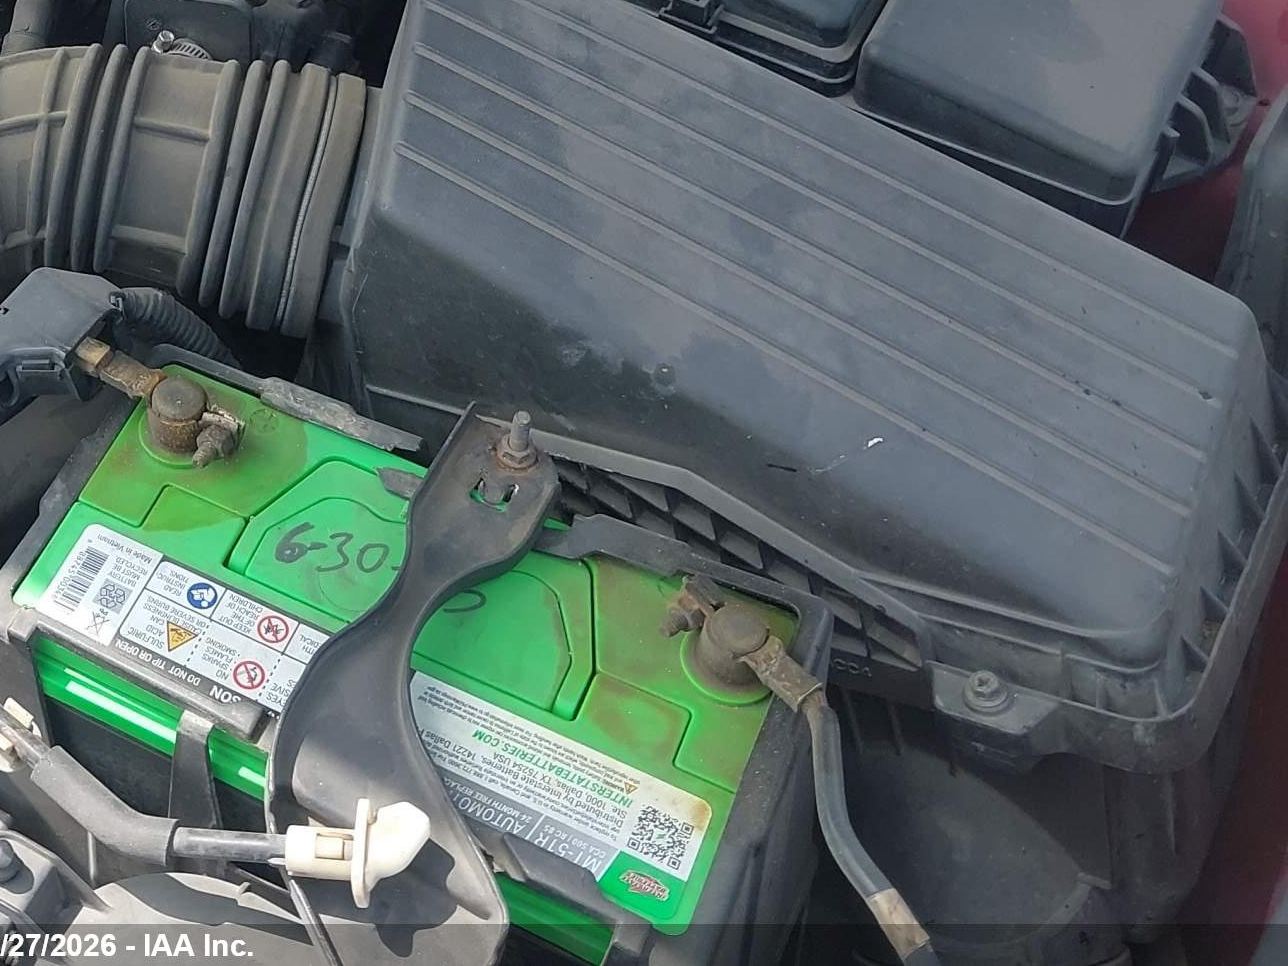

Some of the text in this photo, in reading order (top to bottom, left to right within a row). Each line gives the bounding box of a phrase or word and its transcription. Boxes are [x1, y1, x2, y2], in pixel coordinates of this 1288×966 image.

[96, 533, 152, 564] Made in Vietnam
[107, 569, 136, 587] BATTERY
[112, 562, 140, 581] MUST BE
[162, 583, 182, 596] READ
[142, 602, 202, 635] CAUSE BLINDNESS
[225, 600, 259, 620] REACH OF
[230, 611, 245, 623] THE
[149, 614, 165, 626] CAN
[195, 618, 206, 628] OR
[217, 614, 251, 634] KEEP OUT
[127, 626, 164, 649] SULFURIC
[145, 623, 164, 638] ACID
[138, 649, 153, 662] OR
[151, 656, 167, 669] TIP
[205, 645, 233, 663] FLAMES
[168, 664, 188, 679] NOT
[186, 673, 201, 686] DO
[215, 668, 229, 680] NO
[423, 729, 452, 748] Dallas
[452, 742, 478, 760] 14221
[471, 727, 633, 809] INTERSTATEBATTERIES.COM
[478, 754, 520, 780] Batteries,
[491, 750, 628, 820] Ste. 1000, Dallas, TX 75254 USA
[519, 773, 562, 799] Interstate
[562, 793, 574, 805] by
[449, 791, 525, 837] AUTOMO
[574, 799, 624, 828] Distributed
